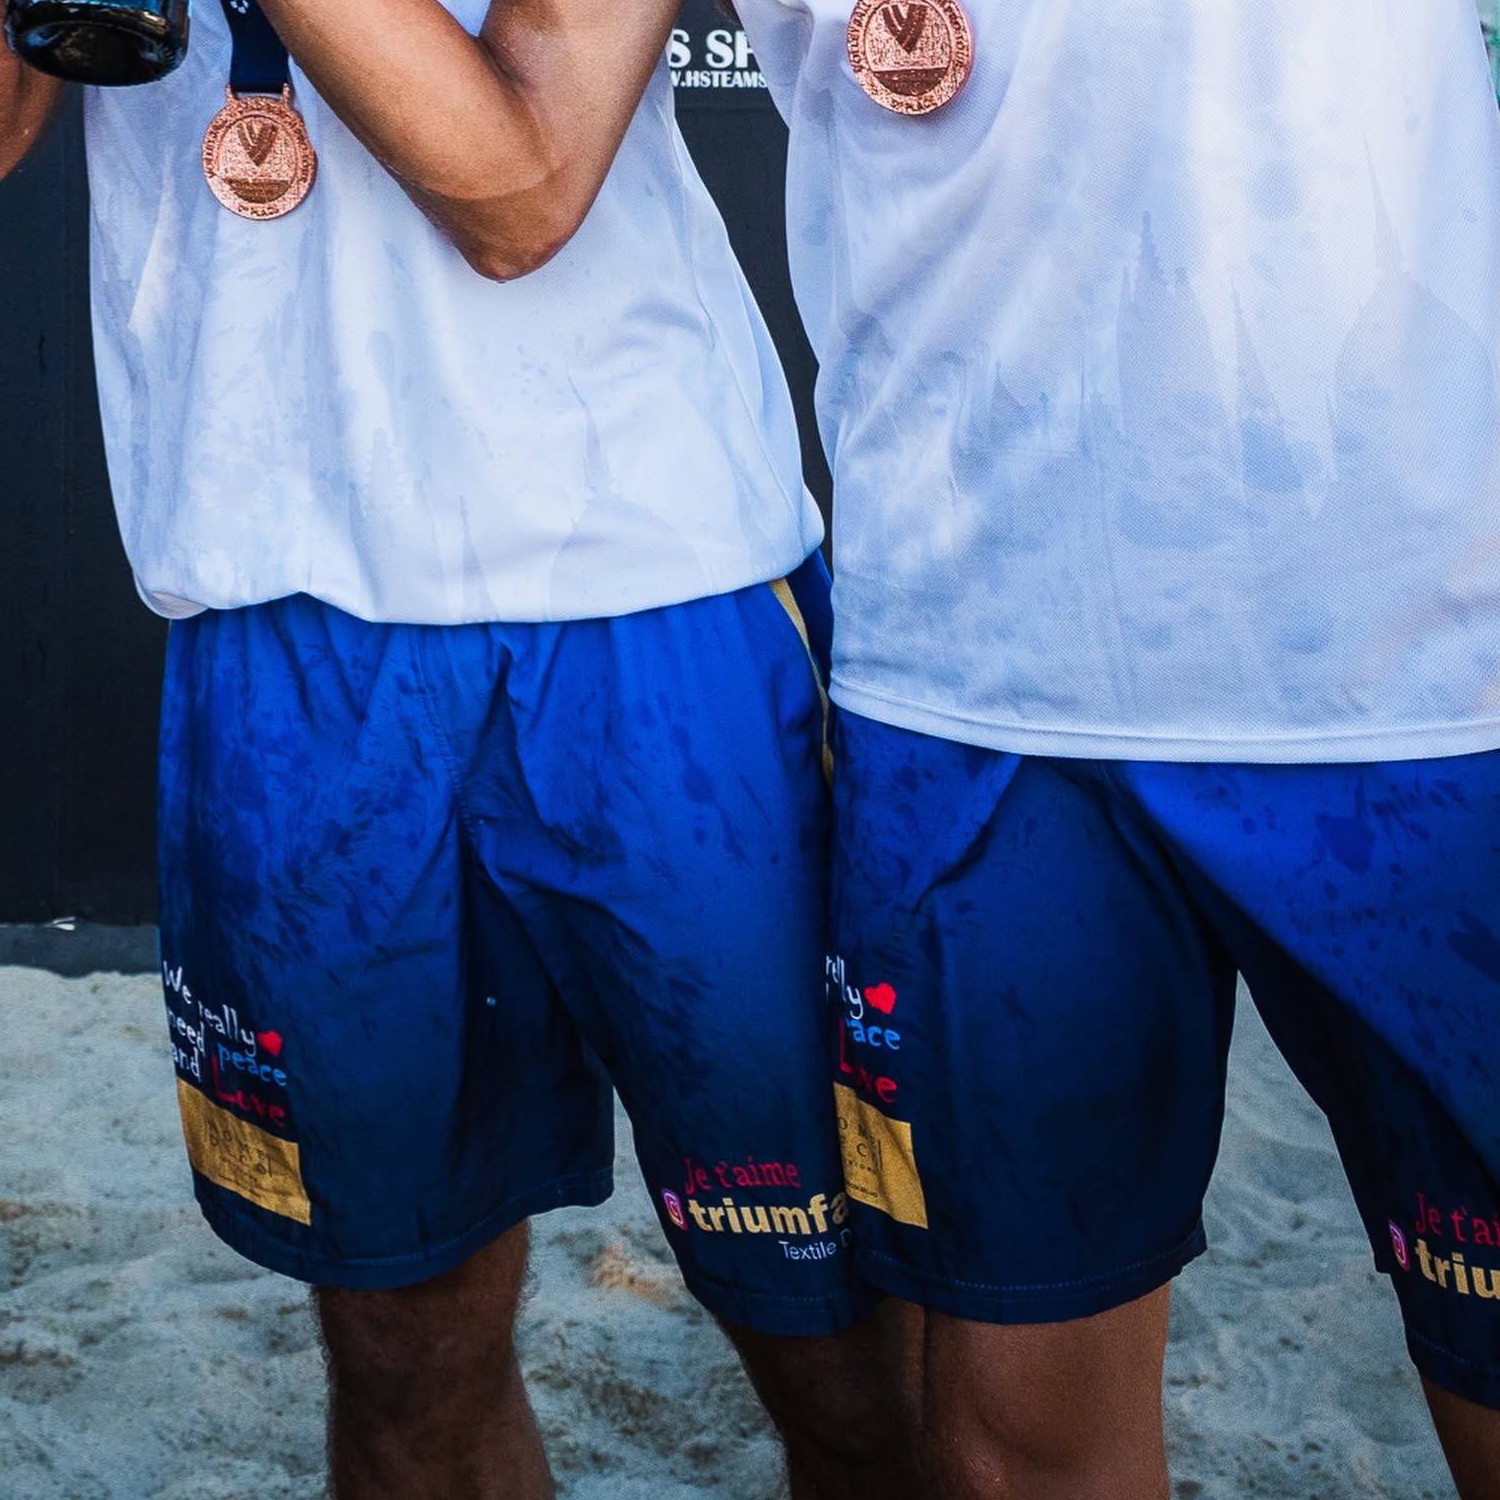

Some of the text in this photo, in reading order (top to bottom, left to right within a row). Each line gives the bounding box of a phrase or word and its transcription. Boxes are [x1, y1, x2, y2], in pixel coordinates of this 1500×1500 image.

[163, 961, 258, 1057] We really
[217, 1042, 288, 1087] peace
[684, 1156, 712, 1195] Je
[1414, 1191, 1443, 1235] Je
[778, 1240, 837, 1261] Textile
